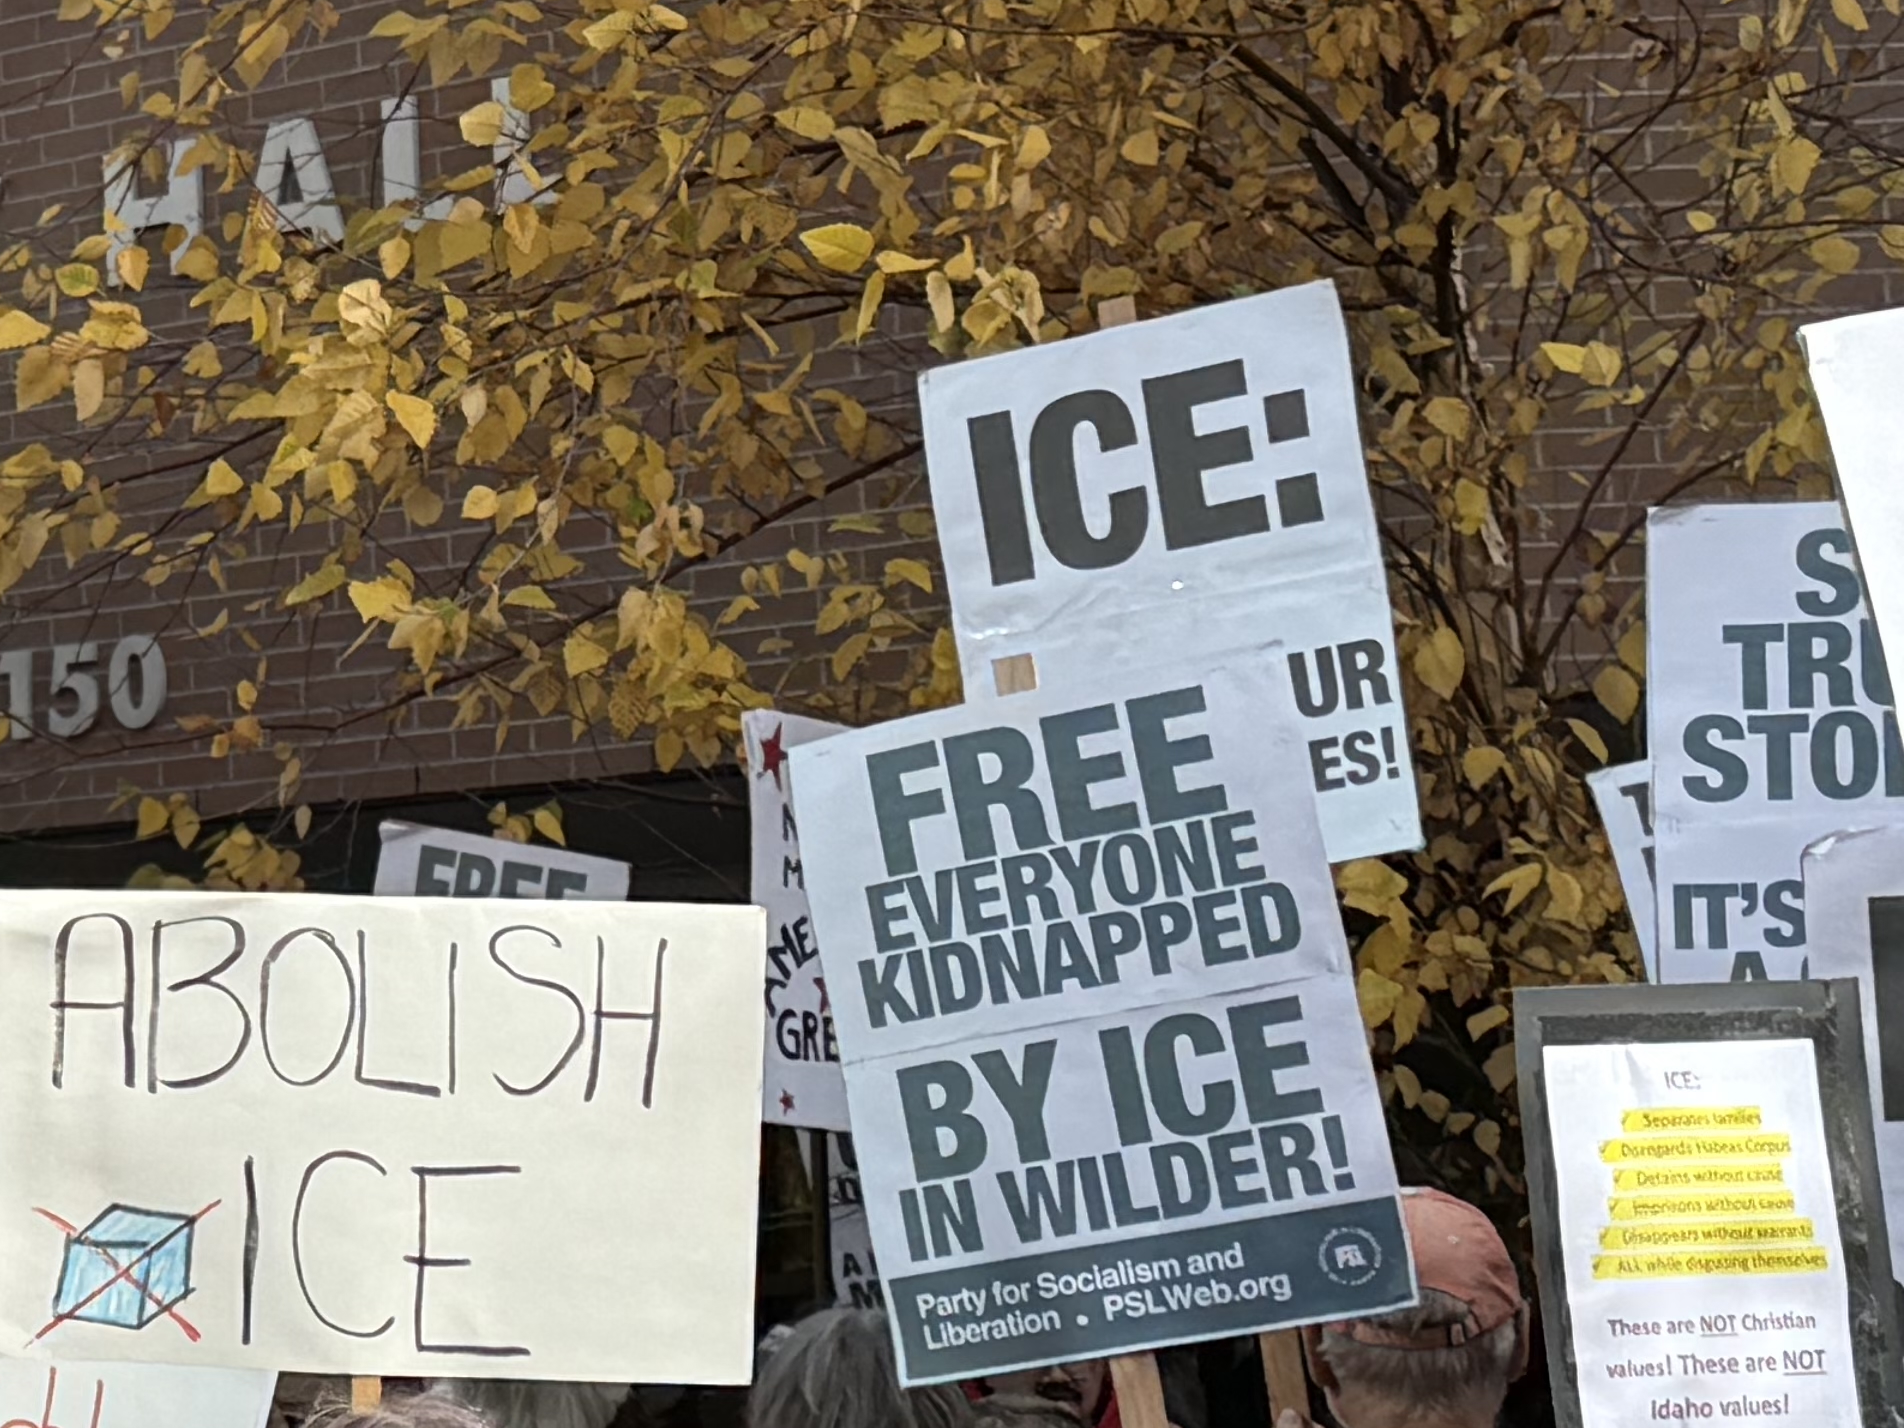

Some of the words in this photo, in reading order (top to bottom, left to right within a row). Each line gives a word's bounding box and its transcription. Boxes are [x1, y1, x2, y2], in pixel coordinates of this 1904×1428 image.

[965, 356, 1325, 587] ICE:
[1287, 637, 1393, 721] UR
[863, 681, 1228, 878] FREE
[855, 878, 1303, 1030] KIDNAPPED
[865, 810, 1266, 955] EVERYONE
[50, 910, 669, 1108] ABOLISH
[1664, 1070, 1702, 1090] ICE:
[895, 1035, 1058, 1185] BY
[1098, 993, 1327, 1147] ICE
[239, 1148, 530, 1357] ICE
[896, 1176, 985, 1264] IN
[994, 1112, 1357, 1244] WILDER!
[915, 1288, 987, 1320] Party
[993, 1278, 1030, 1305] for
[1036, 1256, 1180, 1301] Socialism
[1187, 1242, 1245, 1275] and
[923, 1307, 1061, 1351] Liberation
[1102, 1271, 1293, 1322] PSLWeb.org
[1608, 1318, 1662, 1337] These
[1666, 1320, 1697, 1336] are
[1700, 1314, 1739, 1336] NOT
[1742, 1311, 1817, 1333] Christian
[1605, 1356, 1673, 1381] values!
[1677, 1353, 1740, 1376] These
[1745, 1354, 1778, 1373] are
[1783, 1349, 1828, 1373] NOT
[1650, 1394, 1715, 1421] Idaho
[1720, 1391, 1790, 1419] values!
